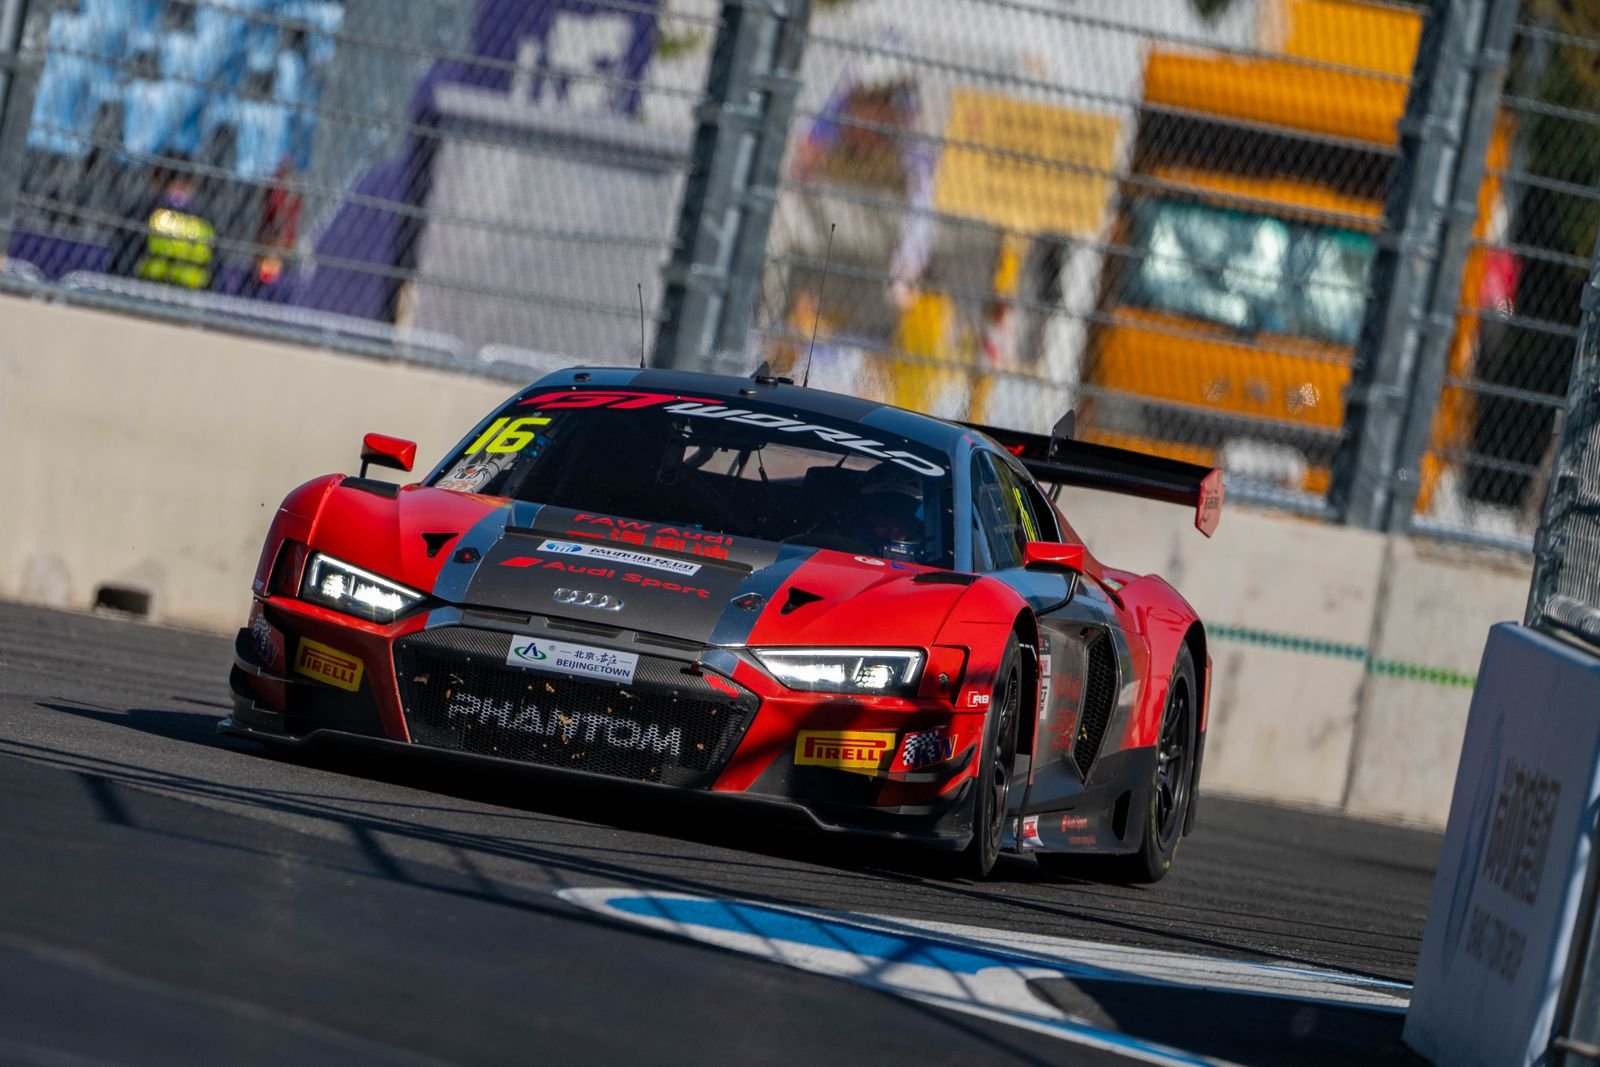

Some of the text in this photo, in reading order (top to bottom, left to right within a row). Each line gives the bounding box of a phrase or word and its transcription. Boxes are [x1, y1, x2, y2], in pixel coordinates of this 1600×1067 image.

[465, 417, 551, 455] 16
[664, 403, 946, 477] WORLD
[573, 513, 734, 545] FAW Audi
[543, 560, 712, 599] Audi Sport
[300, 645, 358, 684] PIRELLI
[556, 658, 631, 678] BEIJINGETOWN
[448, 693, 682, 757] PHANTOM
[804, 736, 887, 761] PIRELLI
